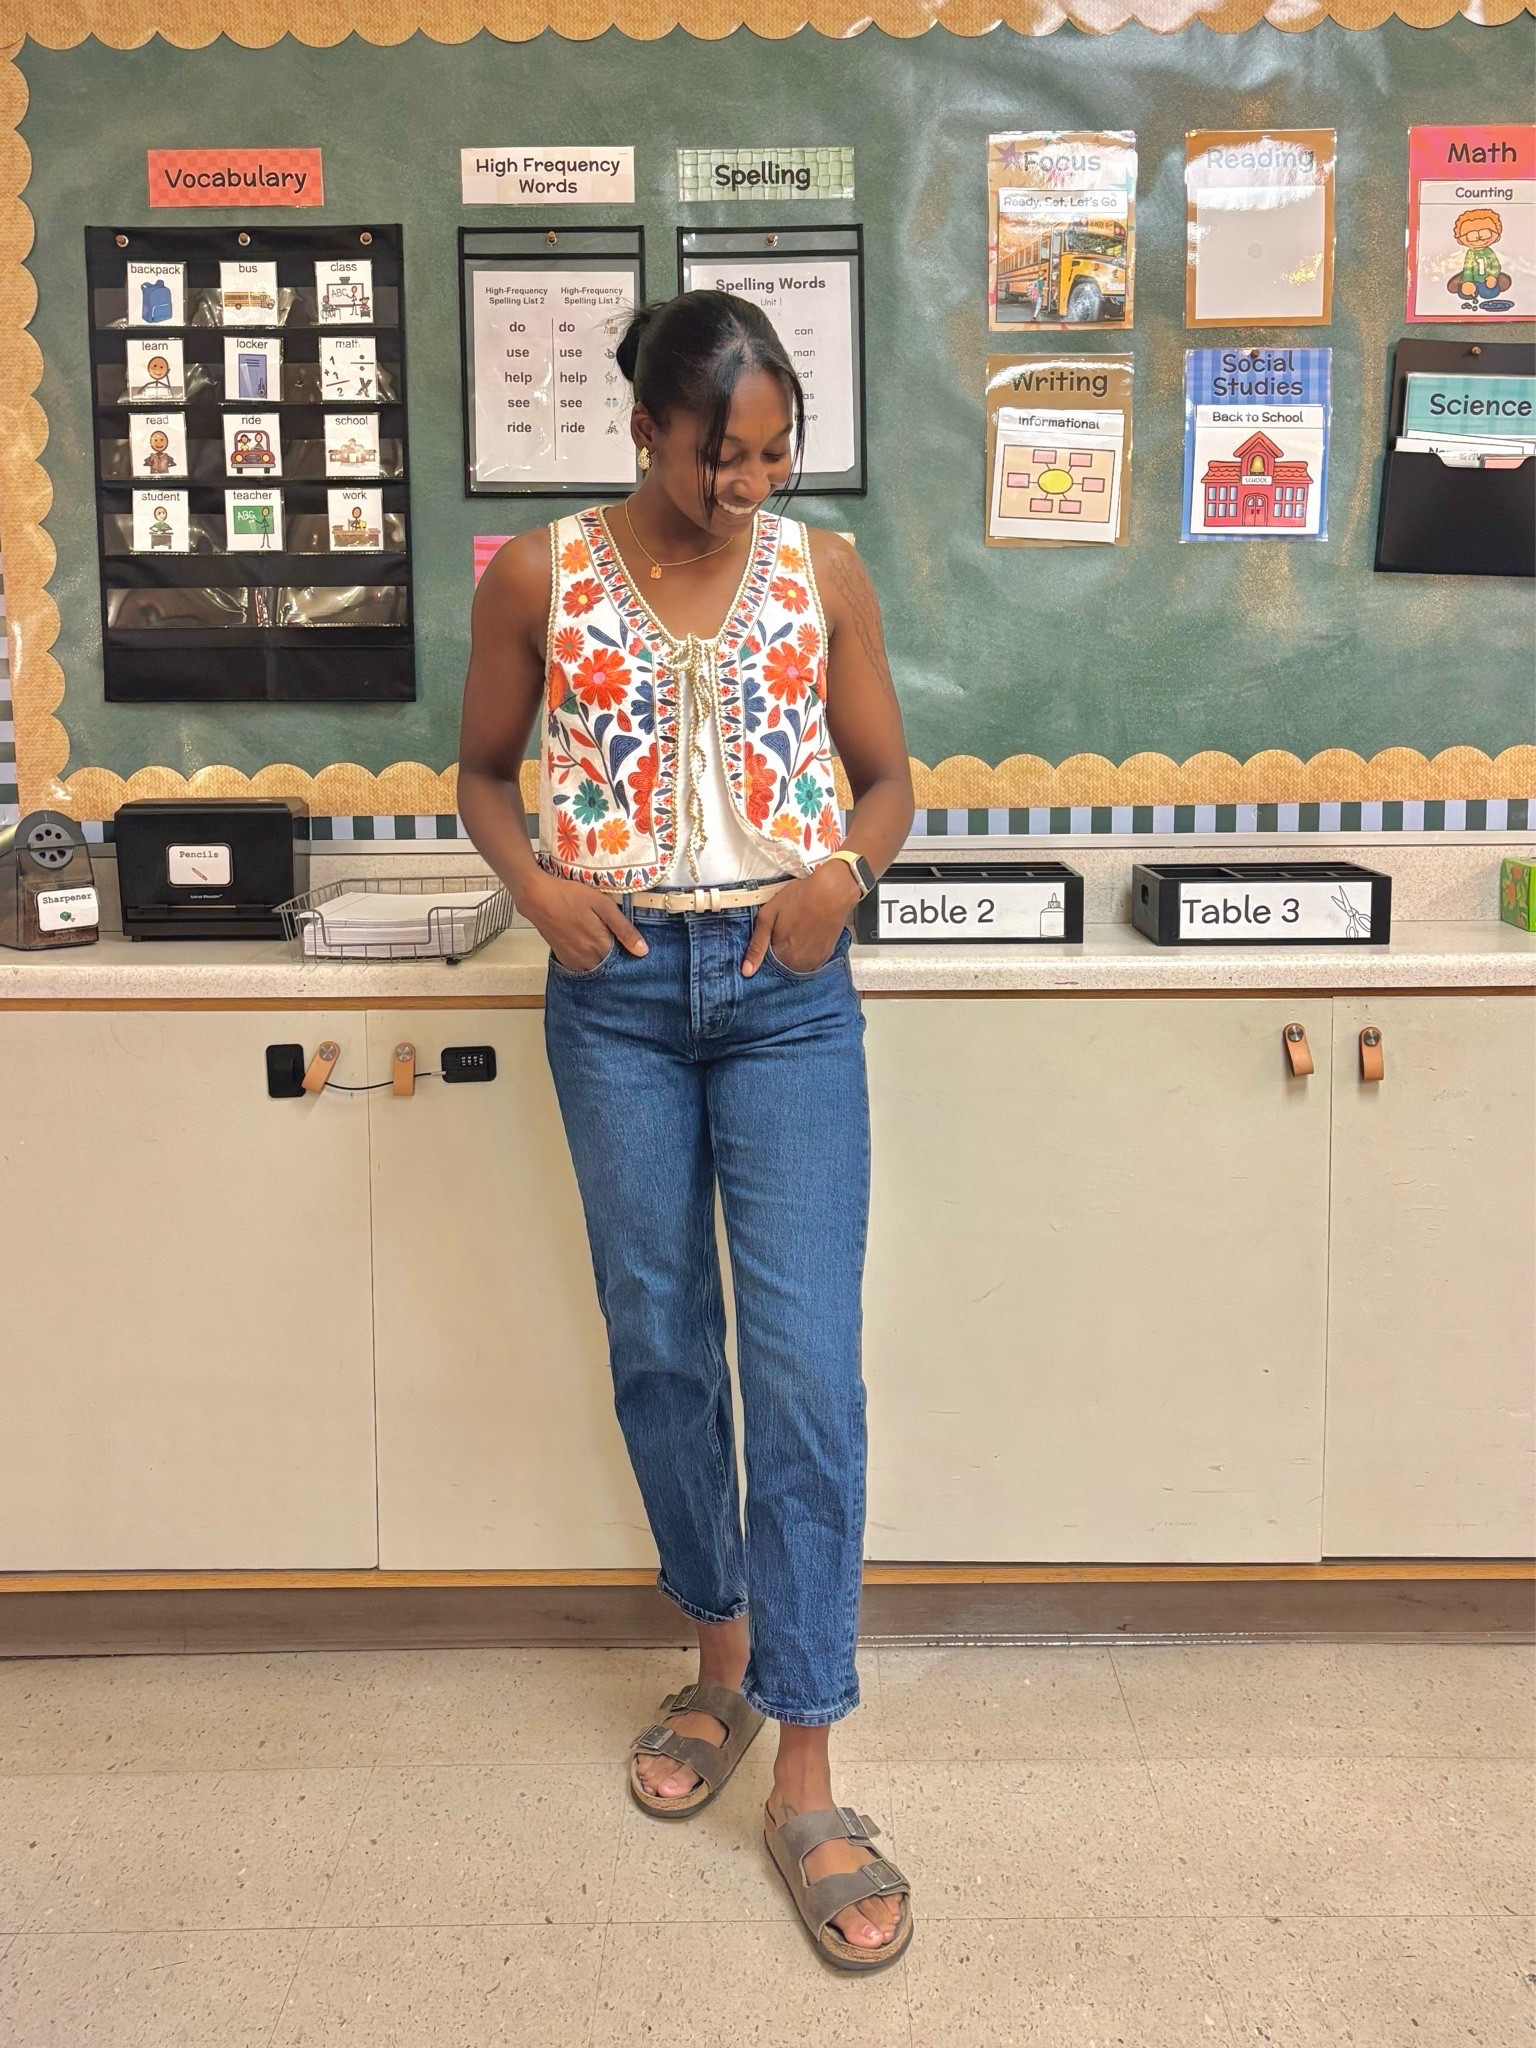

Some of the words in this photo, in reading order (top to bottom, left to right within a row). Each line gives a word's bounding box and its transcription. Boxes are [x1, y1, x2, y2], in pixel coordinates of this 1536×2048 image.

[1447, 141, 1517, 164] Math
[1024, 151, 1102, 172] Focus
[1207, 148, 1315, 174] Reading
[476, 158, 518, 177] High
[523, 157, 620, 176] Frequency
[164, 165, 307, 194] Vocabulary
[715, 161, 811, 191] Spelling
[519, 178, 578, 194] Words
[1455, 186, 1513, 200] Counting
[1003, 196, 1042, 209] Ready,
[1070, 196, 1099, 207] Let's
[1101, 196, 1117, 207] Go
[131, 264, 181, 276] backpack
[239, 262, 258, 273] bus
[330, 261, 358, 272] class
[716, 277, 774, 293] Spelling
[779, 276, 826, 290] Words
[485, 286, 548, 296] High-Frequency
[560, 286, 623, 296] High-Frequency
[489, 296, 522, 306] Spelling
[523, 296, 538, 305] List
[540, 296, 545, 305] 2
[564, 296, 597, 306] Spelling
[599, 296, 614, 305] List
[615, 296, 620, 305] 2
[760, 298, 776, 306] Unit
[509, 321, 526, 333] do
[559, 321, 576, 333] do
[794, 328, 814, 336] can
[141, 340, 169, 351] learn
[236, 339, 268, 349] locker
[506, 349, 530, 358] use
[559, 349, 583, 358] use
[793, 349, 816, 357] man
[1222, 350, 1295, 374] Social
[504, 372, 532, 385] help
[560, 372, 587, 385] help
[797, 370, 814, 378] cat
[1013, 371, 1108, 398] Writing
[1213, 376, 1303, 396] Studies
[507, 399, 530, 408] see
[560, 399, 583, 408] see
[1430, 393, 1532, 416] Science
[146, 415, 169, 425] read
[242, 415, 262, 425] ride
[335, 415, 368, 426] school
[1212, 411, 1243, 422] Back
[1246, 411, 1259, 422] to
[1262, 411, 1304, 423] School
[507, 422, 532, 433] ride
[560, 422, 585, 433] ride
[141, 491, 181, 502] student
[233, 490, 272, 500] teacher
[342, 490, 367, 500] work
[179, 850, 219, 859] Pencils
[42, 893, 92, 904] Sharpener
[880, 894, 967, 925] Table
[977, 898, 995, 923] 2
[1182, 894, 1271, 925] Table
[1281, 898, 1300, 924] 3
